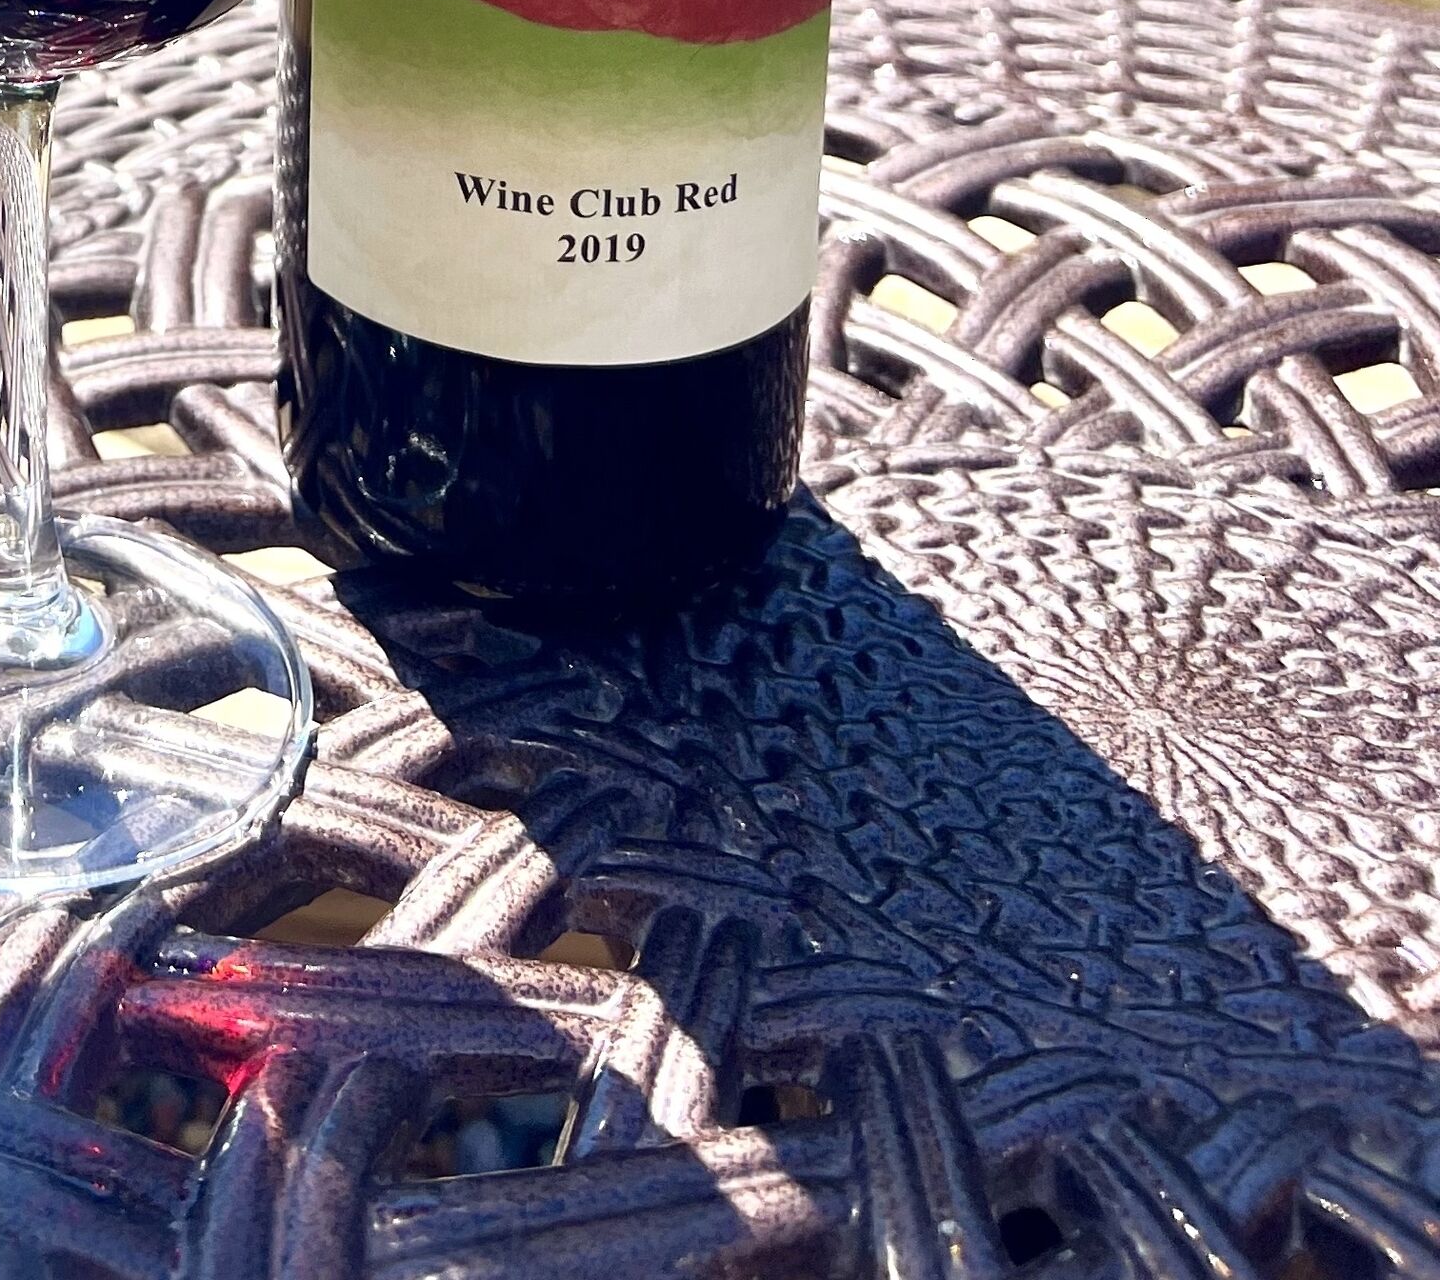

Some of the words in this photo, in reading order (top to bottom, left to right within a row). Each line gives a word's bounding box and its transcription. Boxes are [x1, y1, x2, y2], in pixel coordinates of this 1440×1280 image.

[454, 171, 555, 216] Wine
[570, 187, 661, 218] Club
[674, 173, 738, 213] Red
[556, 233, 646, 263] 2019
